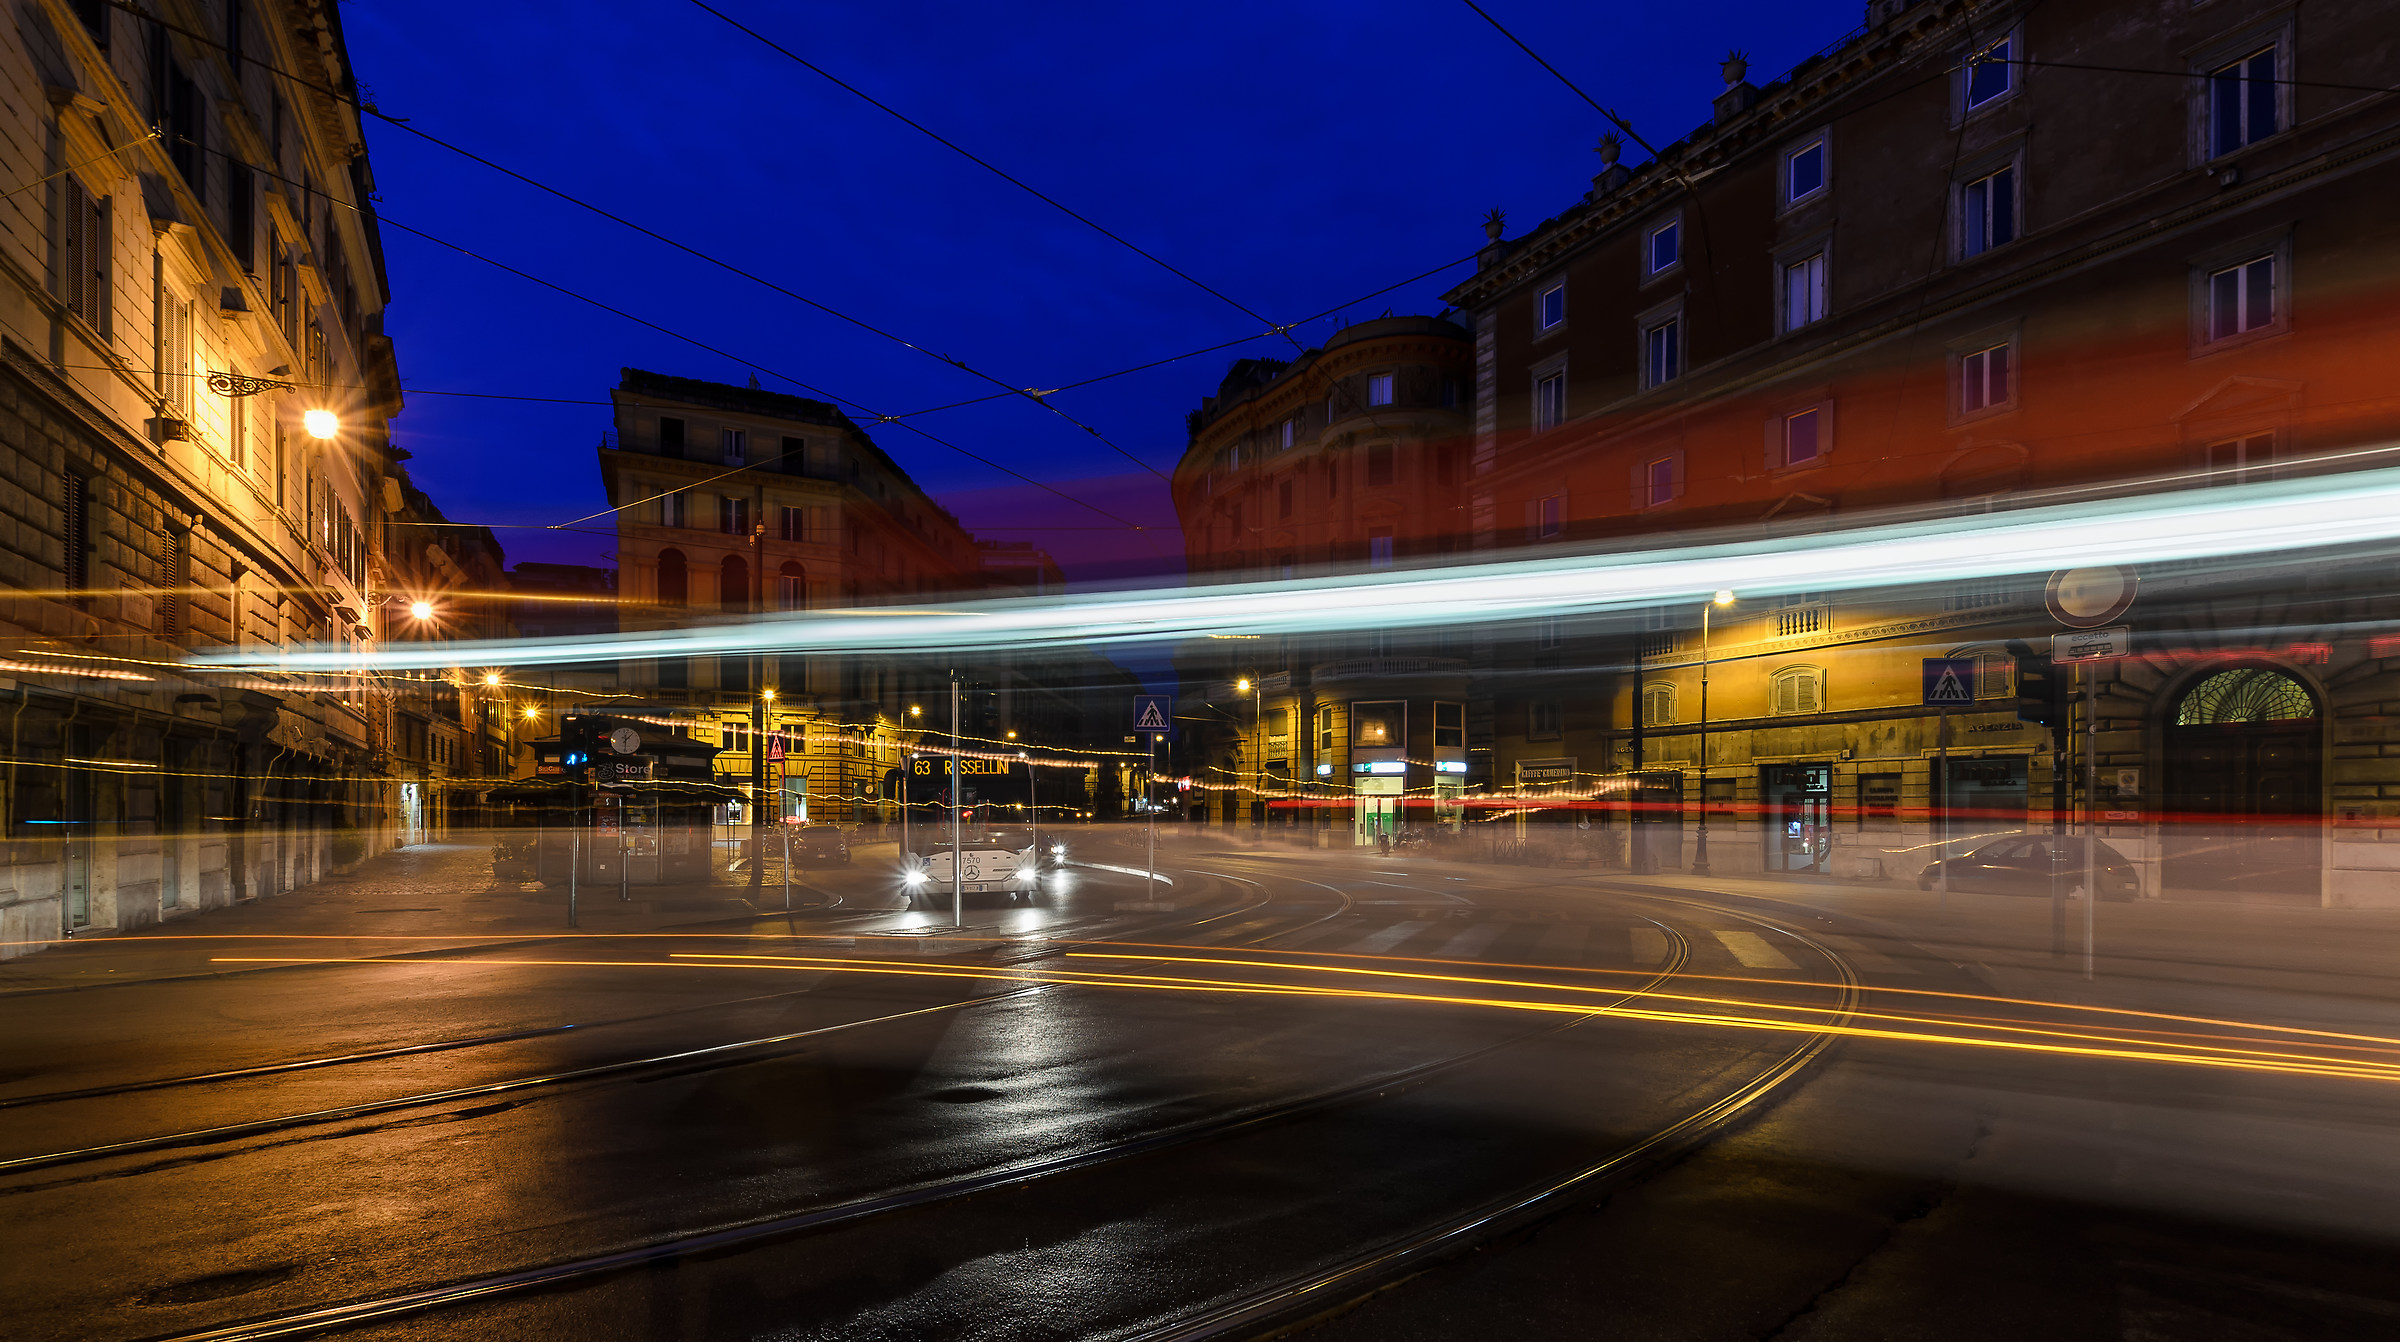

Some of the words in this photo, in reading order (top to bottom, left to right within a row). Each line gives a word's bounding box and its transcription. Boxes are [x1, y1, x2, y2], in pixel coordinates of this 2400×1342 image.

[2071, 631, 2109, 641] eccetto
[1968, 722, 2024, 732] AGENZIA
[615, 763, 651, 774] Store
[914, 760, 931, 775] 63
[944, 759, 1010, 775] RSSELLINI
